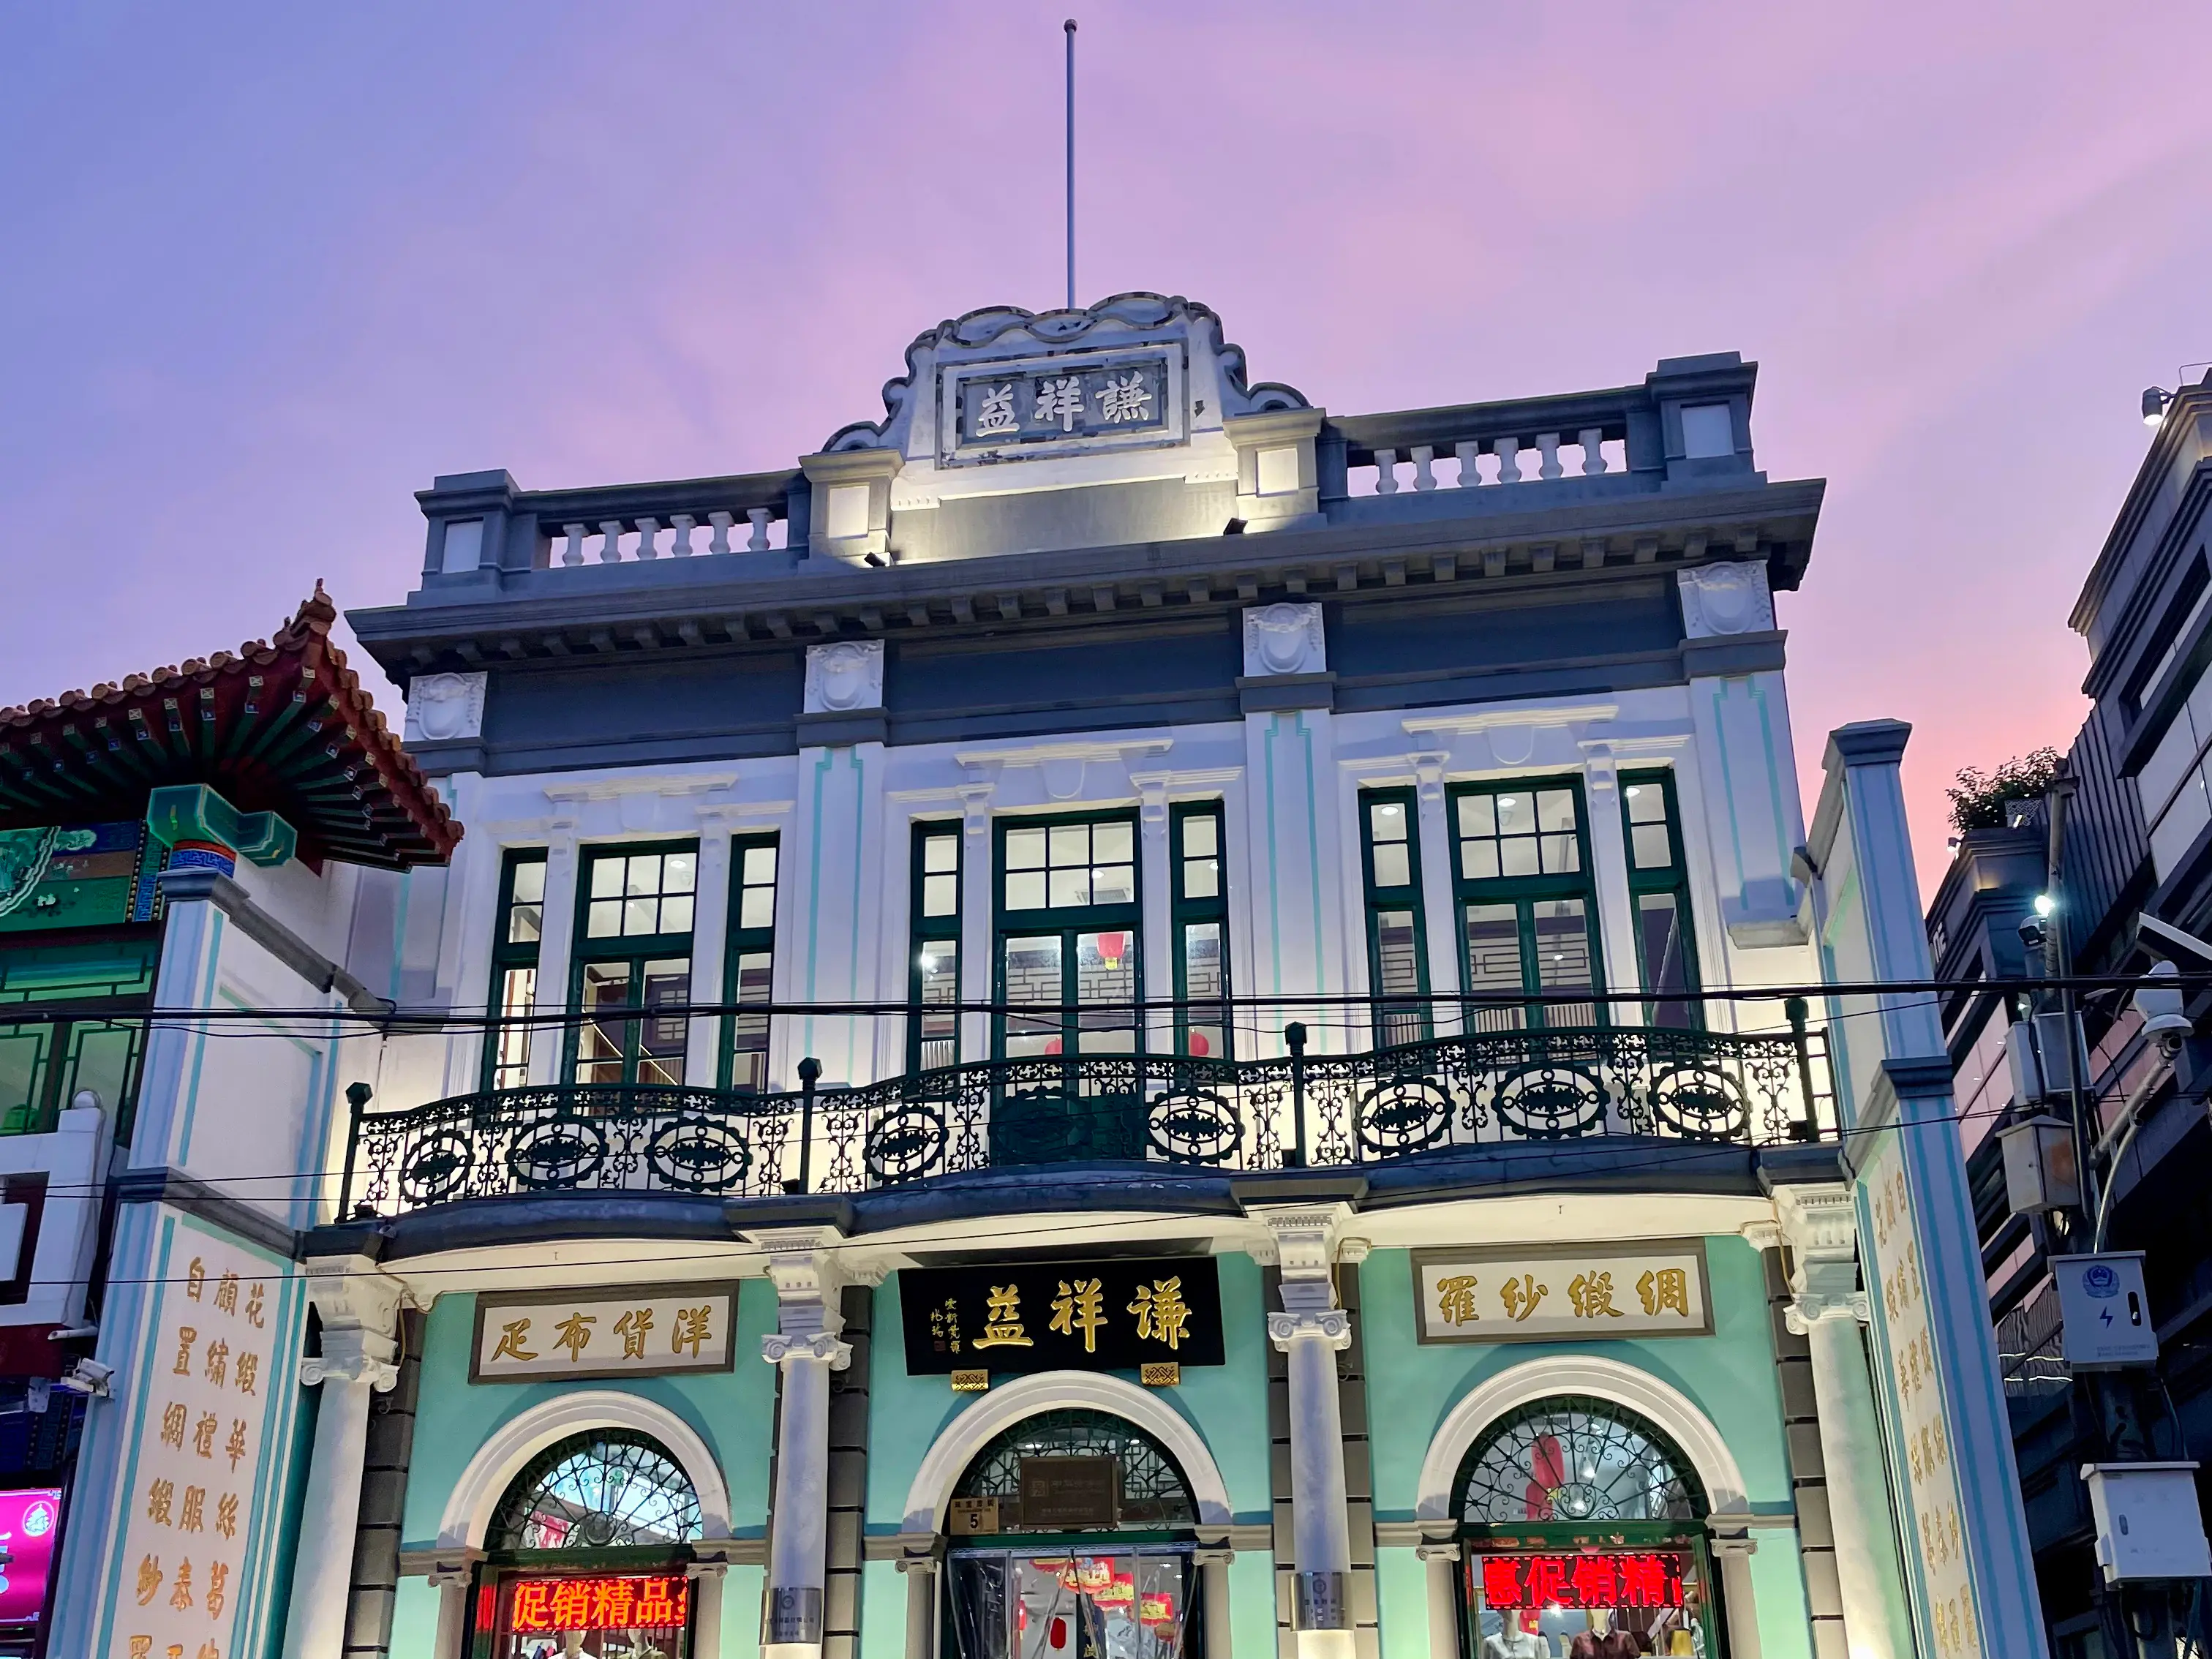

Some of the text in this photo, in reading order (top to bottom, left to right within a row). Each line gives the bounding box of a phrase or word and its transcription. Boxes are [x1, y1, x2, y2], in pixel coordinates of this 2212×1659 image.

[970, 1513, 978, 1529] 5
[1484, 1556, 1683, 1606] 惠促销精
